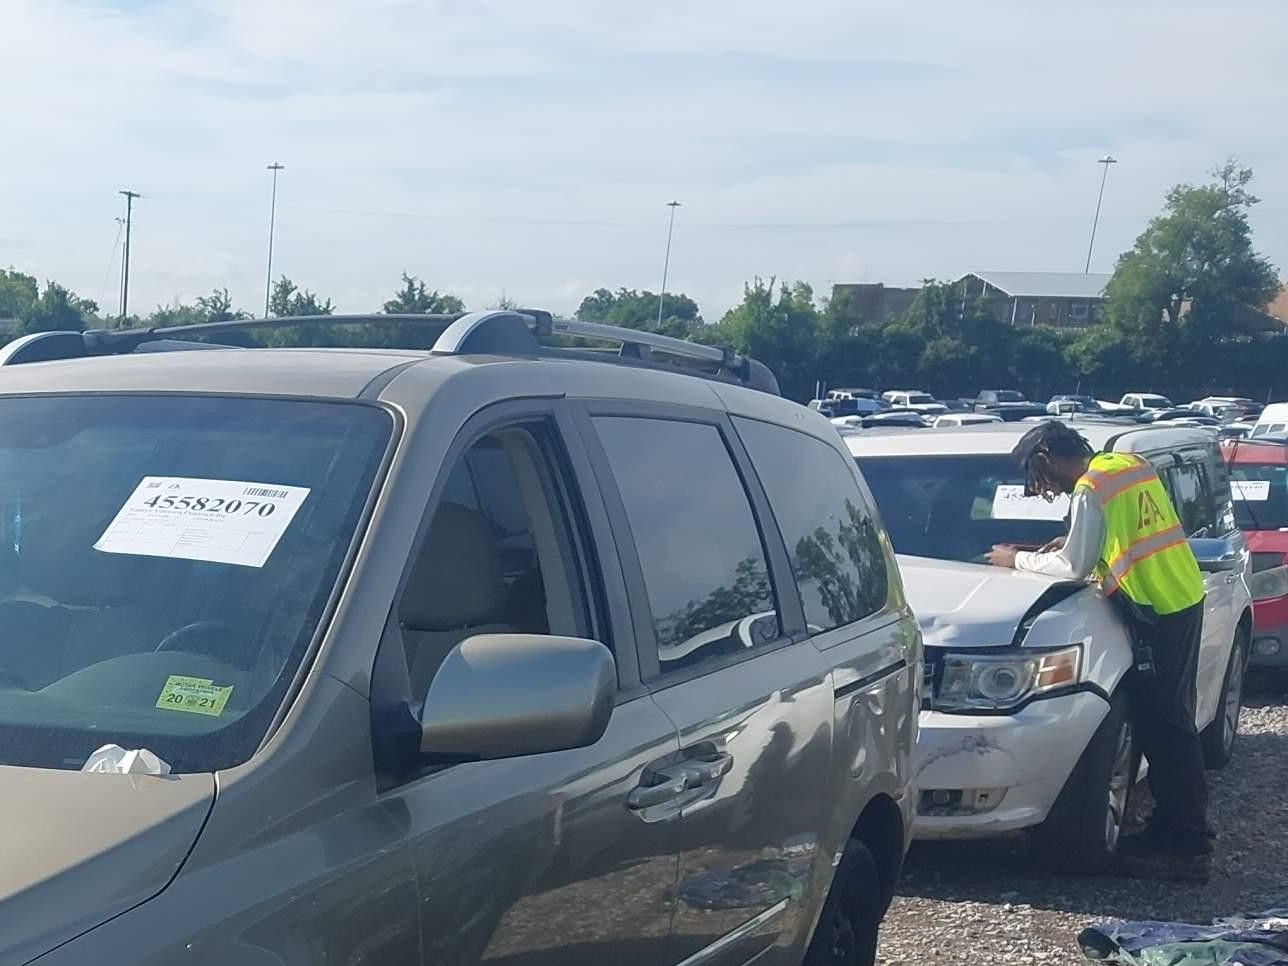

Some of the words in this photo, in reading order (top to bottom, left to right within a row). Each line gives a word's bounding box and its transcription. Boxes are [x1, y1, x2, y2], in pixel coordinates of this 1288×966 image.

[143, 494, 275, 518] 45582070
[166, 693, 183, 703] 20
[199, 697, 216, 708] 21
